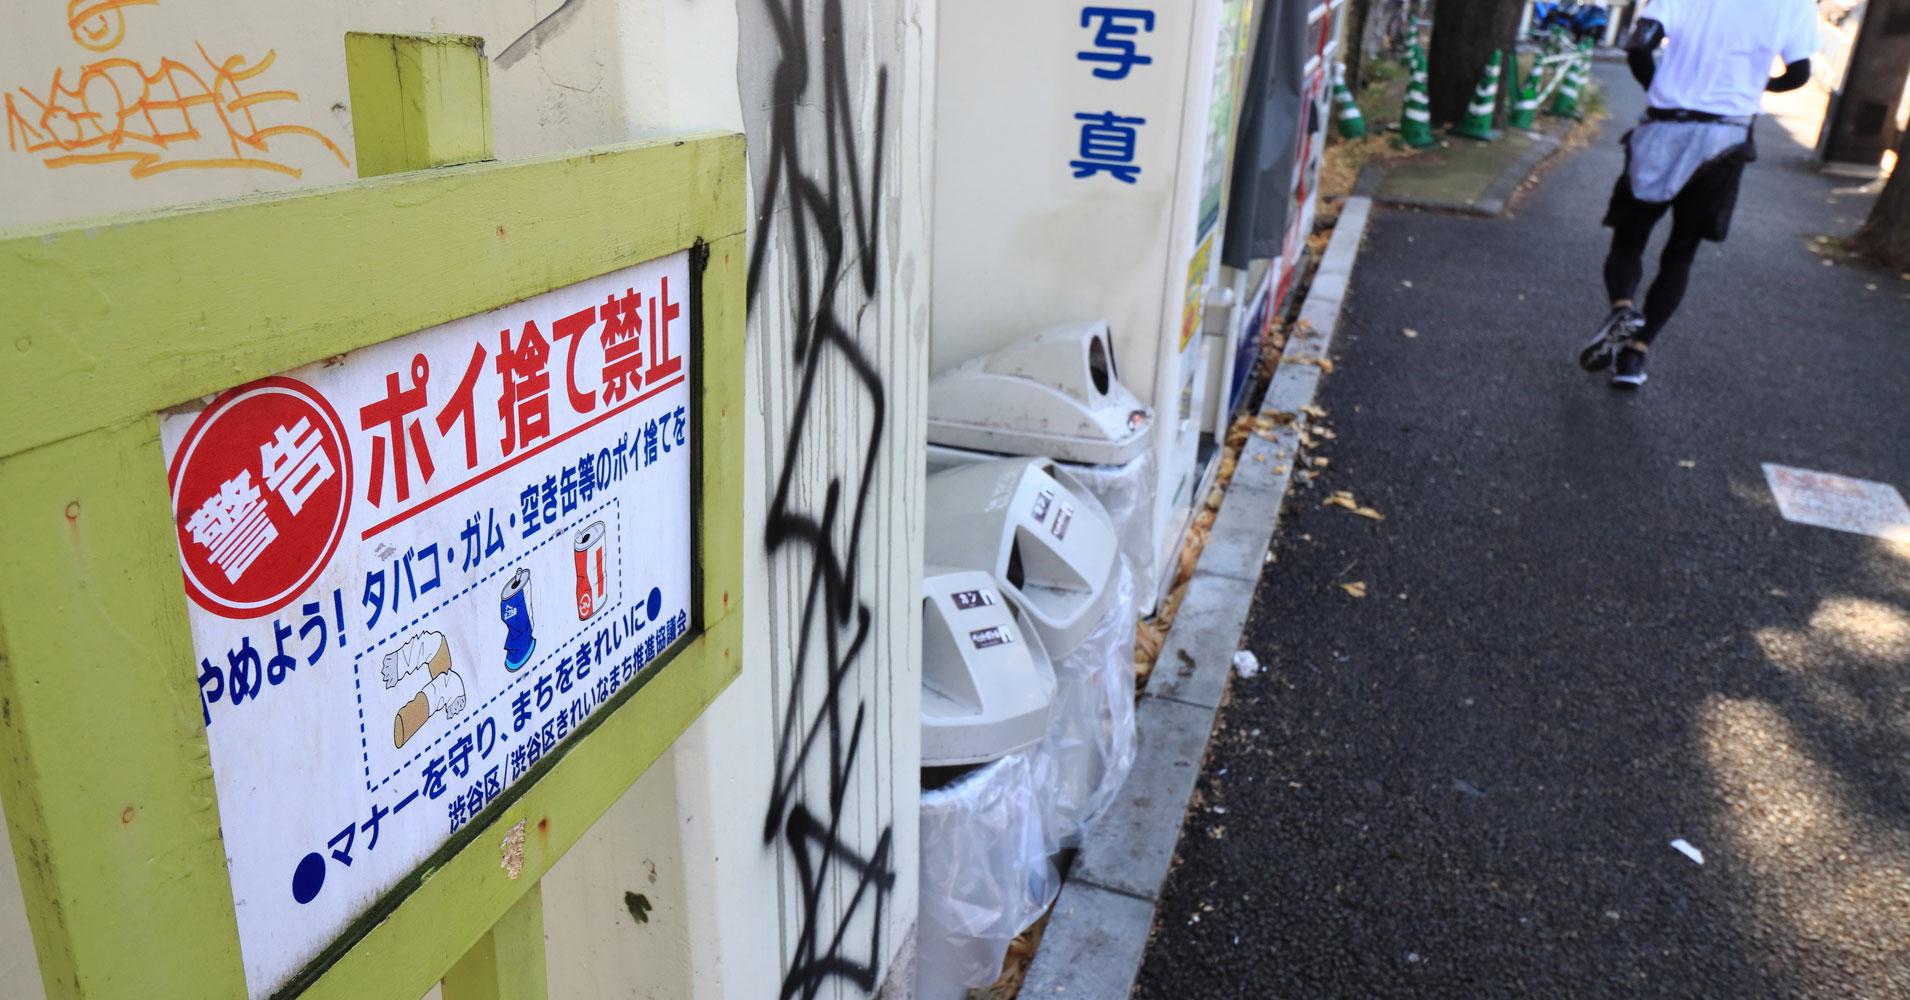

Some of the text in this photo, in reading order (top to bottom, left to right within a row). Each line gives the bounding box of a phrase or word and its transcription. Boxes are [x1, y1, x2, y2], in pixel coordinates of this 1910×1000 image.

[1068, 6, 1156, 184] 写真
[359, 276, 683, 509] ポイ捨て禁止
[186, 415, 337, 585] 警告
